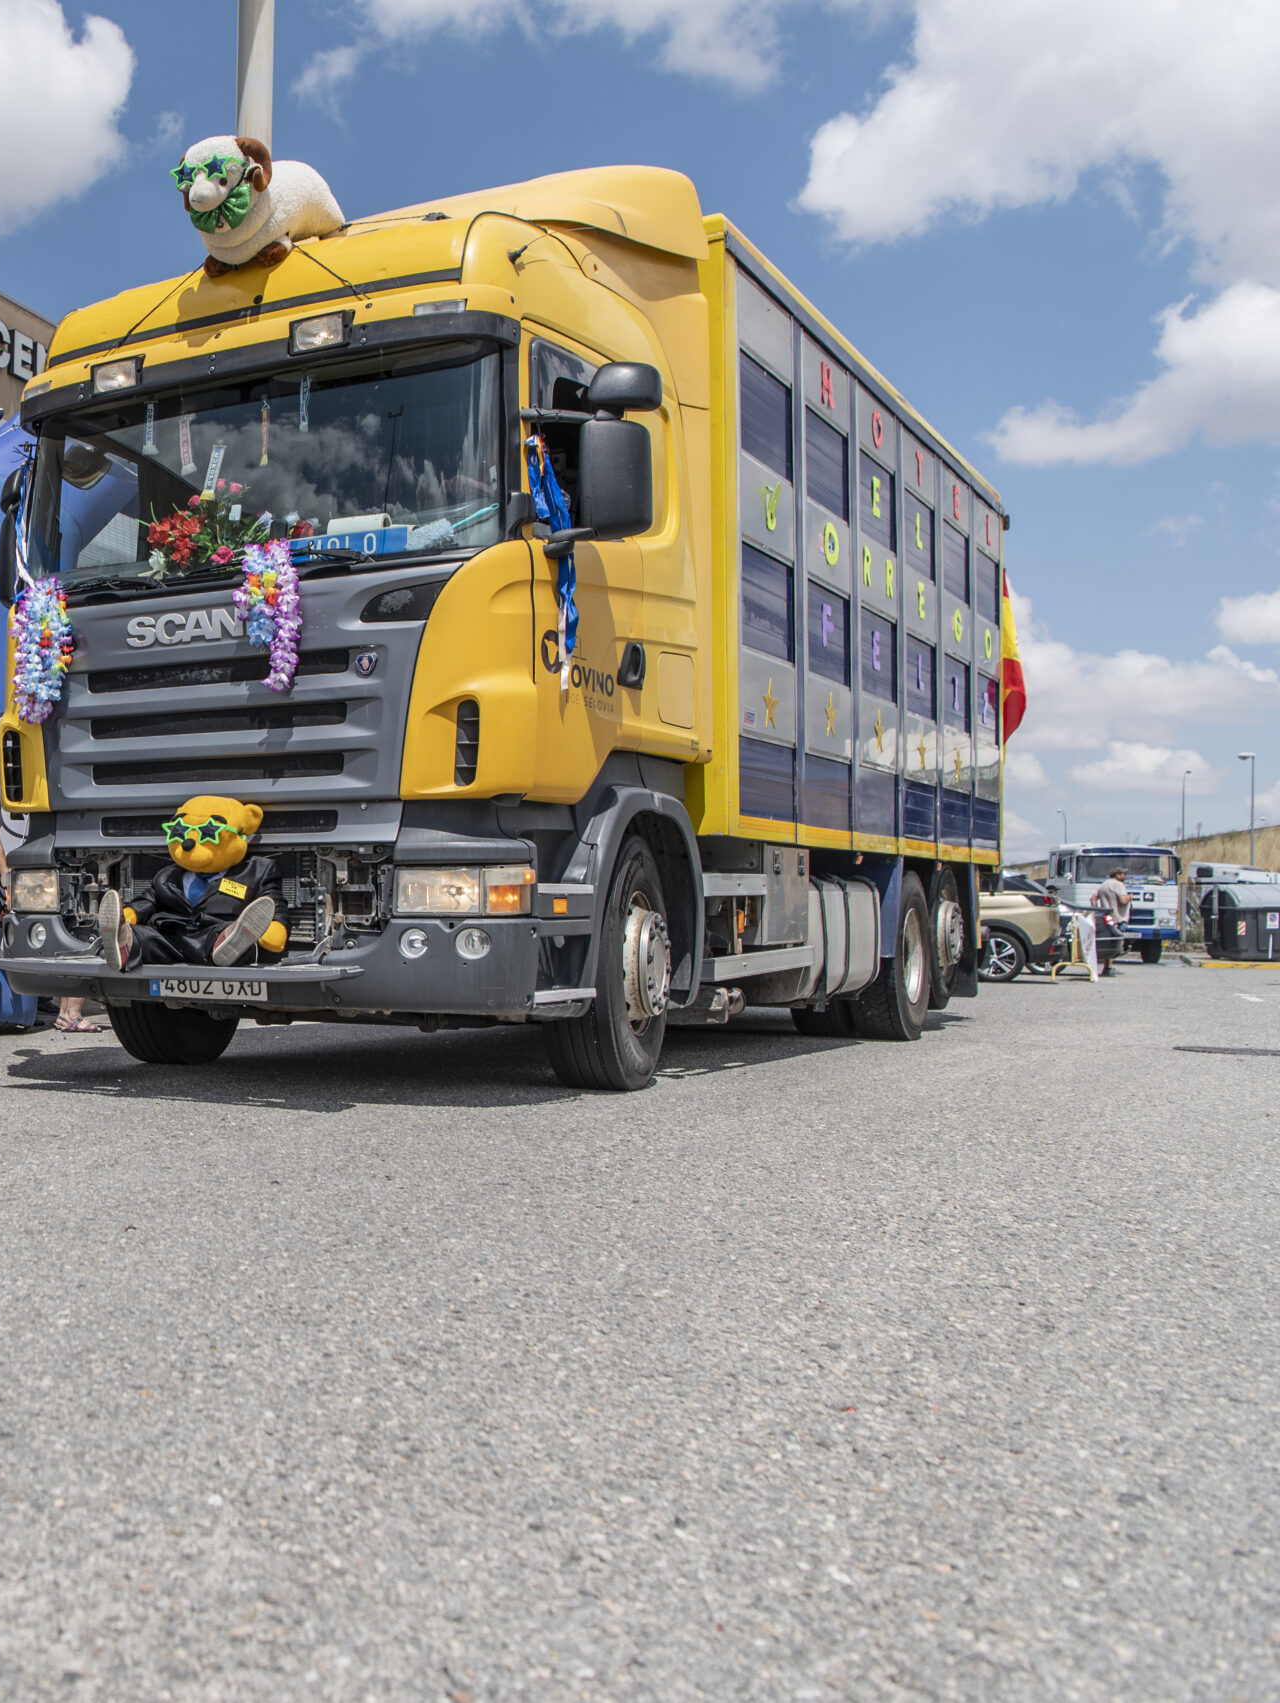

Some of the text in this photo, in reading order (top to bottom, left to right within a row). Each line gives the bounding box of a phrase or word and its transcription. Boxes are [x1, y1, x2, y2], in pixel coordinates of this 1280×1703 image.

[821, 360, 992, 546] HOTEL
[126, 608, 248, 648] SCAN
[571, 664, 615, 697] OVINO
